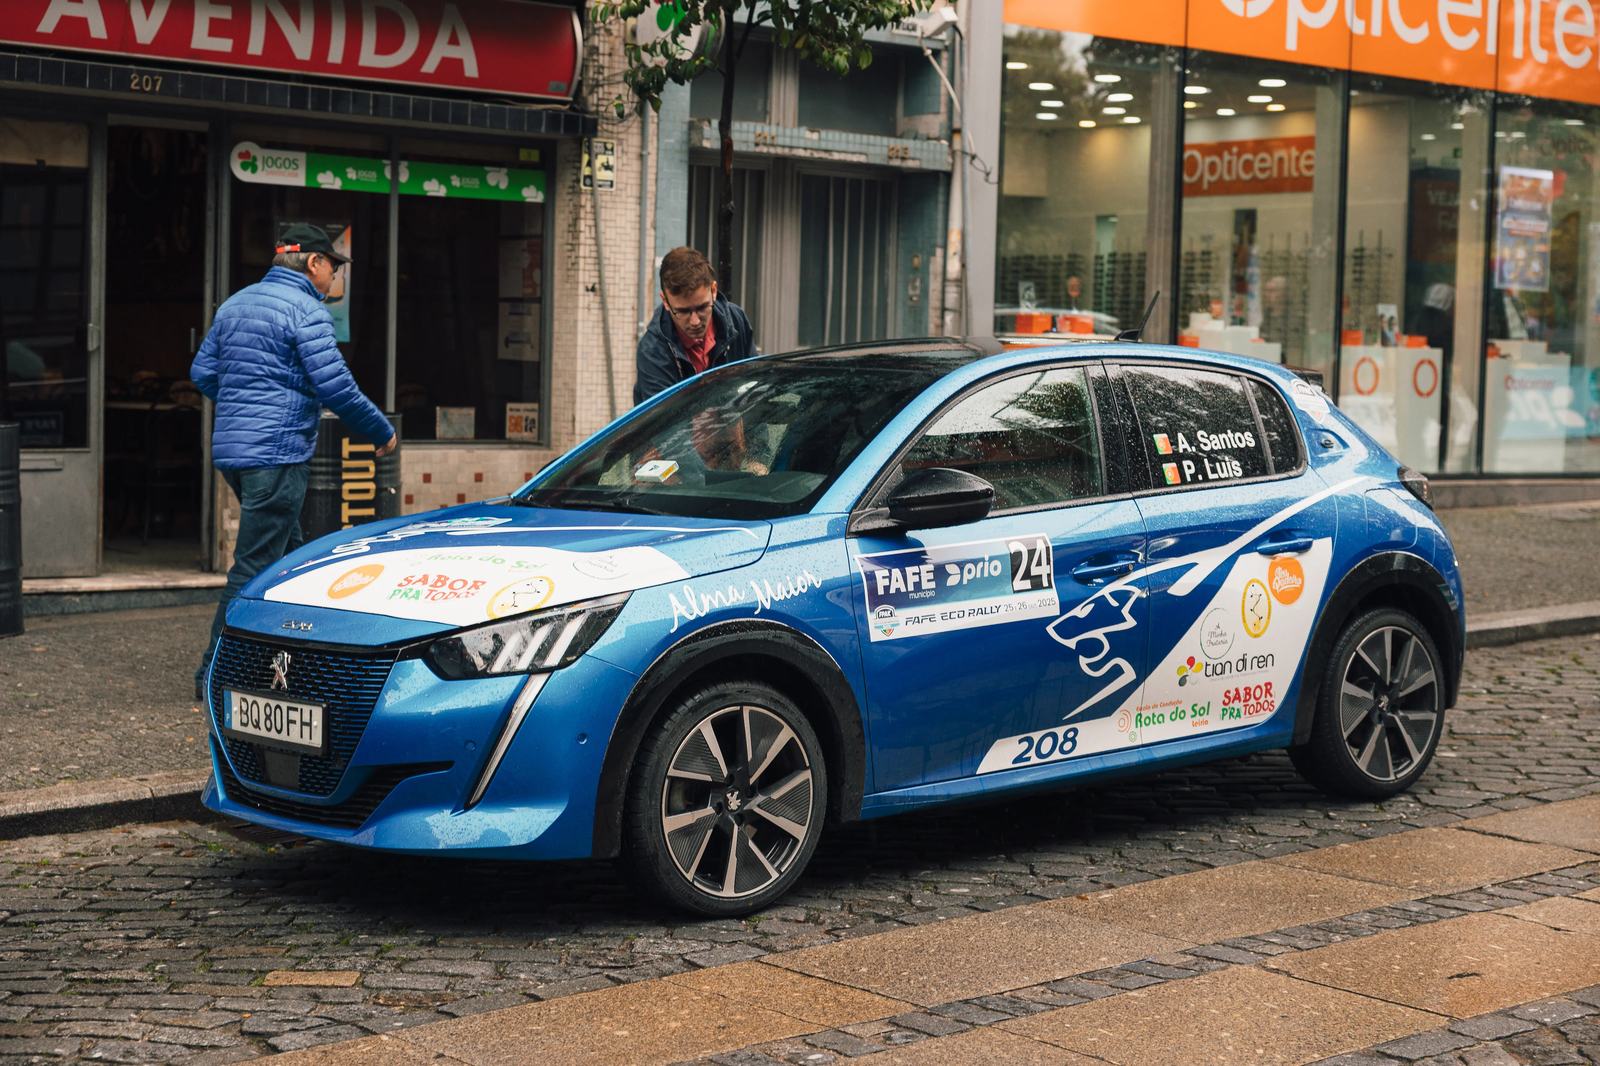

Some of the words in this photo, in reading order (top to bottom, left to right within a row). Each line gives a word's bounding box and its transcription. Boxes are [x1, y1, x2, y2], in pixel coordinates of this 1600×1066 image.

[36, 0, 479, 78] AVENIDA
[1219, 0, 1595, 68] pticente
[130, 74, 163, 93] 207
[261, 155, 299, 171] JOGOS
[1183, 146, 1316, 190] Opticente
[1177, 432, 1196, 453] A.
[1197, 429, 1256, 451] Santos
[341, 437, 376, 530] TOUT
[1183, 460, 1203, 481] P.
[963, 553, 1002, 585] prio
[1008, 539, 1051, 590] 24
[397, 574, 487, 591] SABOR
[875, 564, 936, 595] FAFE
[668, 584, 745, 633] Alma
[905, 613, 937, 626] FAFE
[940, 609, 966, 621] ECO
[967, 604, 1002, 618] RALLY
[1003, 603, 1014, 613] 25
[1017, 601, 1028, 611] 26
[1037, 597, 1057, 608] 2025
[1204, 660, 1232, 677] tian
[1236, 653, 1247, 673] di
[1251, 653, 1275, 671] ren
[1222, 681, 1273, 706] SABOR
[1243, 700, 1275, 716] TODOS
[1135, 711, 1165, 728] Rota
[1169, 706, 1186, 722] do
[1190, 701, 1210, 719] Sol
[1012, 727, 1079, 764] 208
